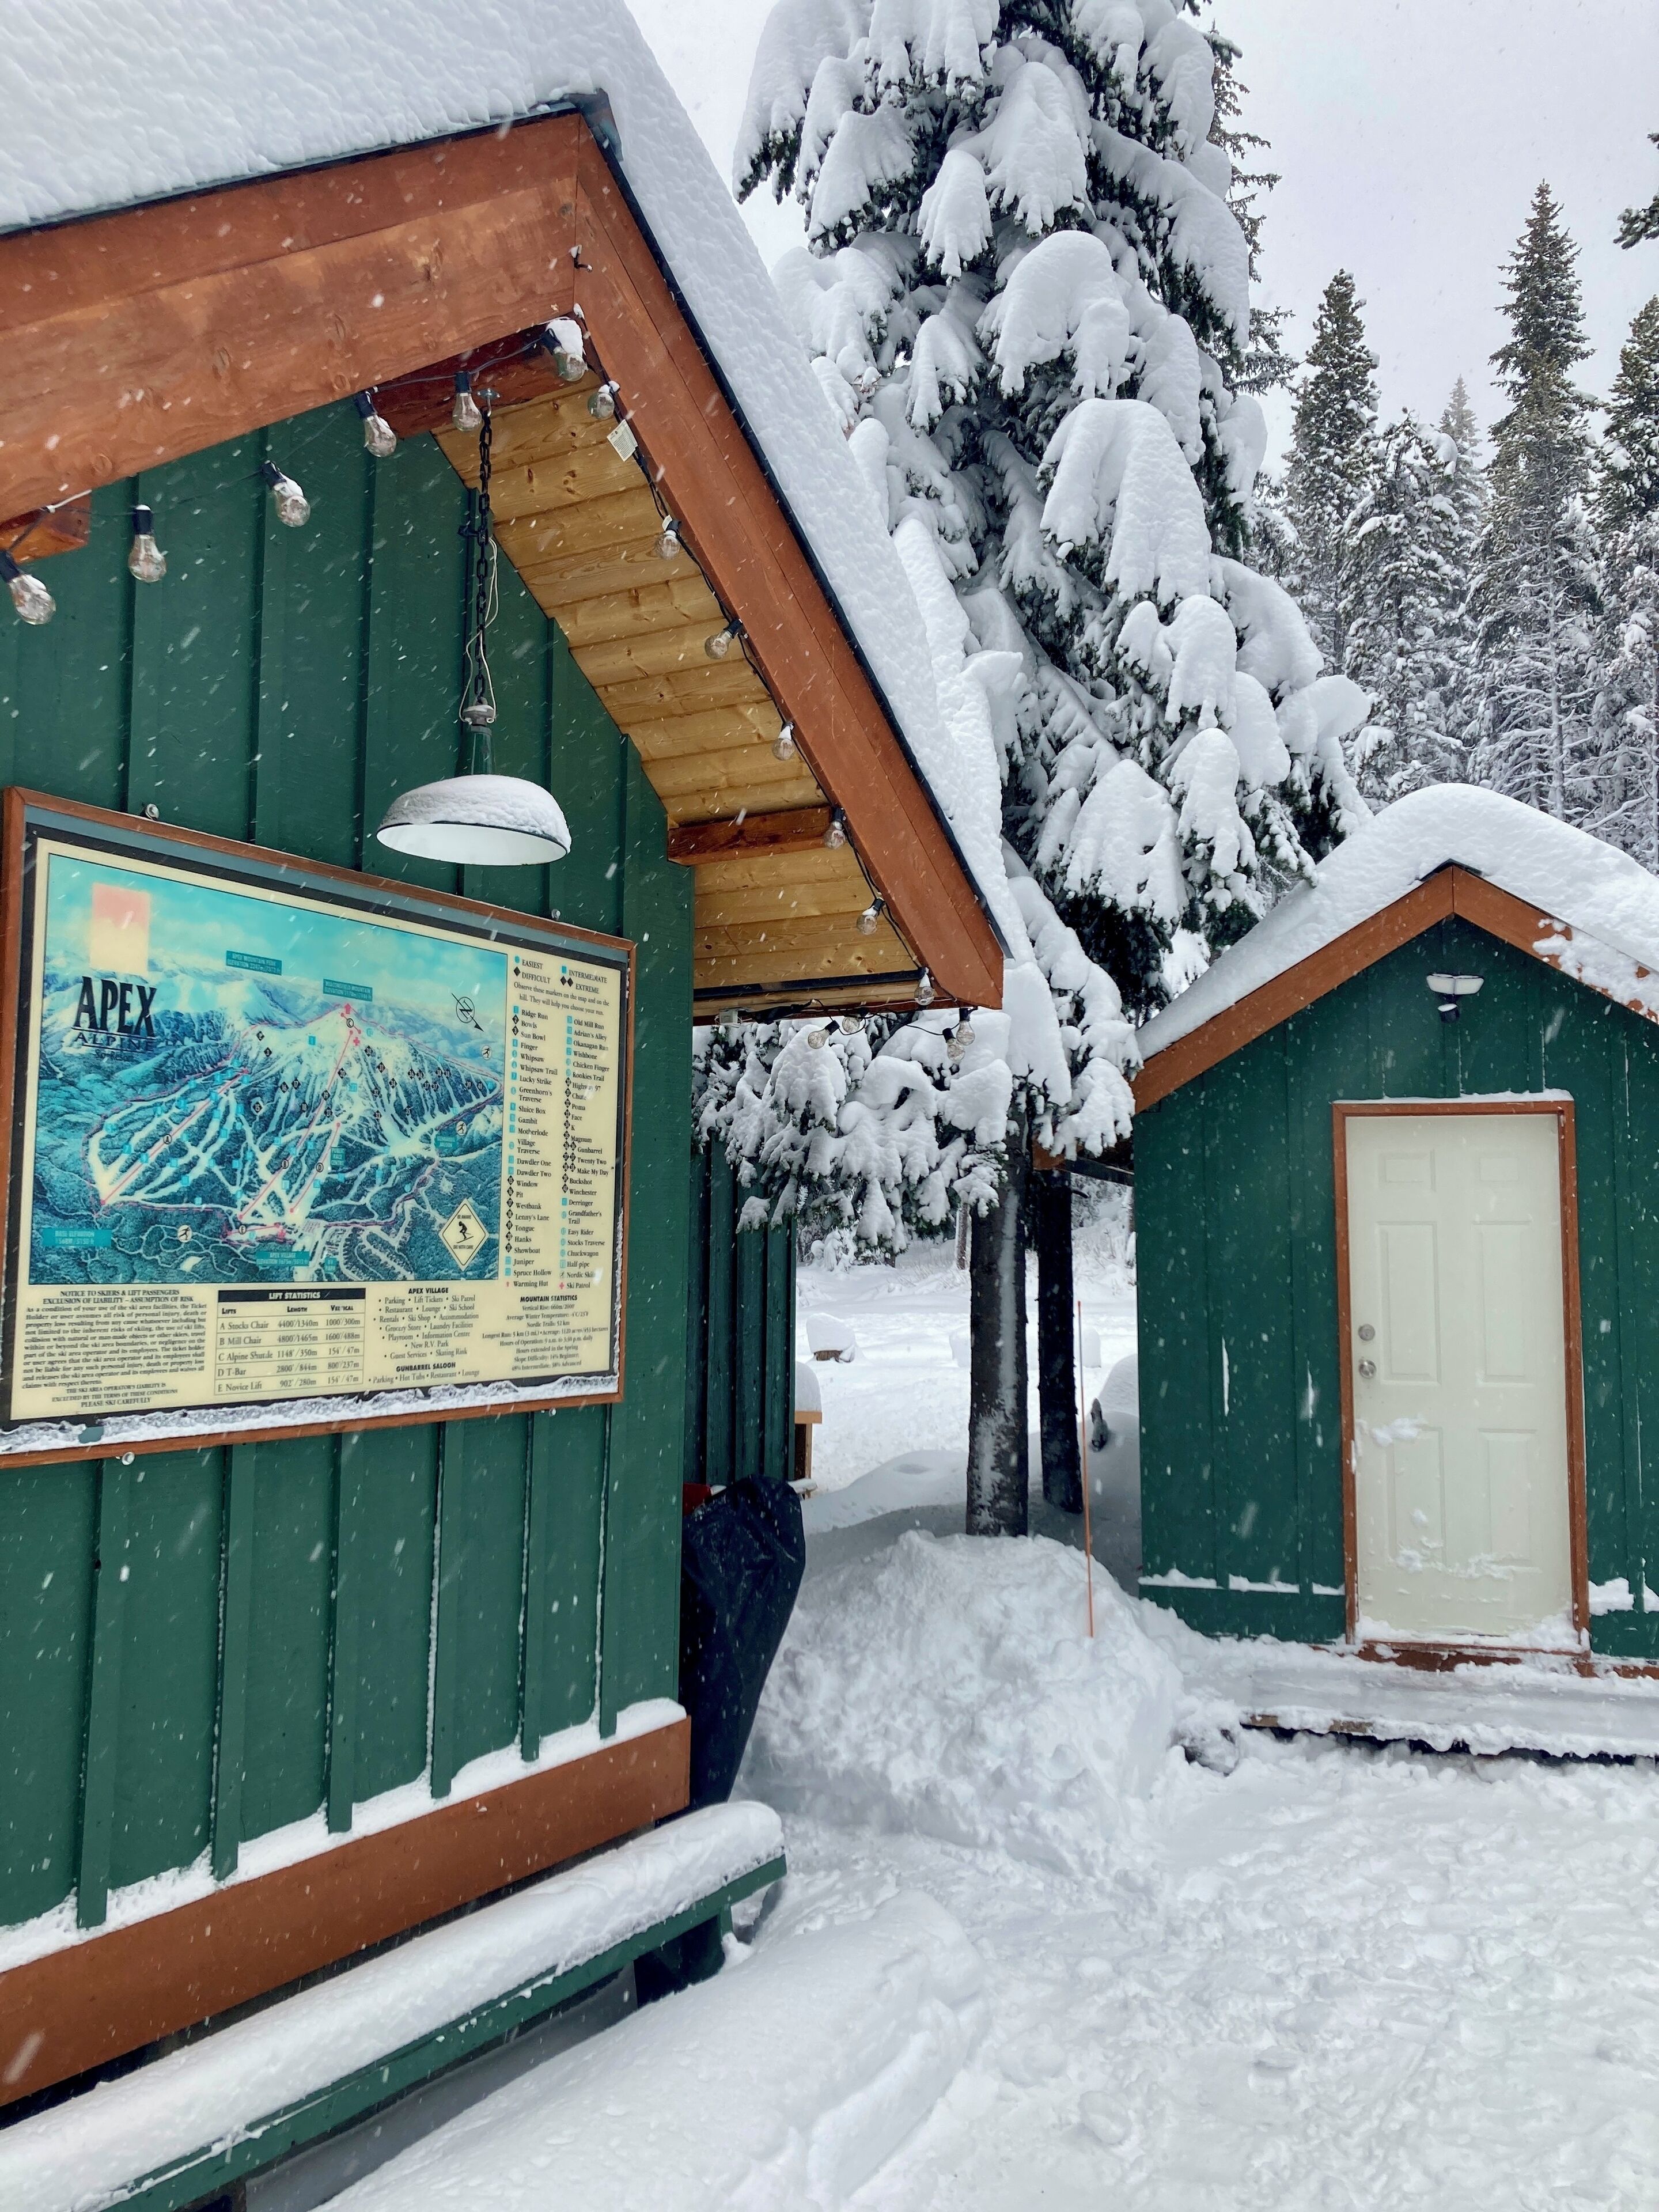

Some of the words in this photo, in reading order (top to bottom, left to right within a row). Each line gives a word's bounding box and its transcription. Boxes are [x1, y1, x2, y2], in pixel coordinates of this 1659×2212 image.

[522, 959, 543, 969] EASIEST
[522, 972, 551, 983] DIFFICULT
[569, 969, 607, 983] INTERMEDIATE
[514, 982, 532, 991] Observe
[578, 995, 587, 1003] map
[576, 983, 599, 994] EXTREME
[530, 995, 540, 1005] They
[551, 1000, 560, 1008] help
[73, 976, 157, 1037] APEX
[521, 1010, 536, 1018] Ridge
[521, 1020, 537, 1028] Bowls
[532, 1033, 546, 1041] Bowl
[574, 1030, 593, 1038] Adrian's
[594, 1033, 607, 1041] Alley
[74, 1032, 154, 1051] ALPINE
[573, 1041, 598, 1050] Okanagan
[521, 1043, 538, 1051] Finger
[521, 1054, 545, 1062] Whipsaw
[573, 1051, 597, 1059] Wishbone
[520, 1065, 544, 1073] Whipsaw
[573, 1062, 593, 1070] Chicken
[594, 1064, 610, 1072] Finger
[520, 1087, 552, 1096] Greenhorn's
[518, 1128, 548, 1136] Motherlode
[518, 1139, 535, 1147] Village
[396, 1364, 431, 1372] GUNBARREL
[373, 1376, 394, 1384] Parking
[226, 1383, 248, 1391] Novice
